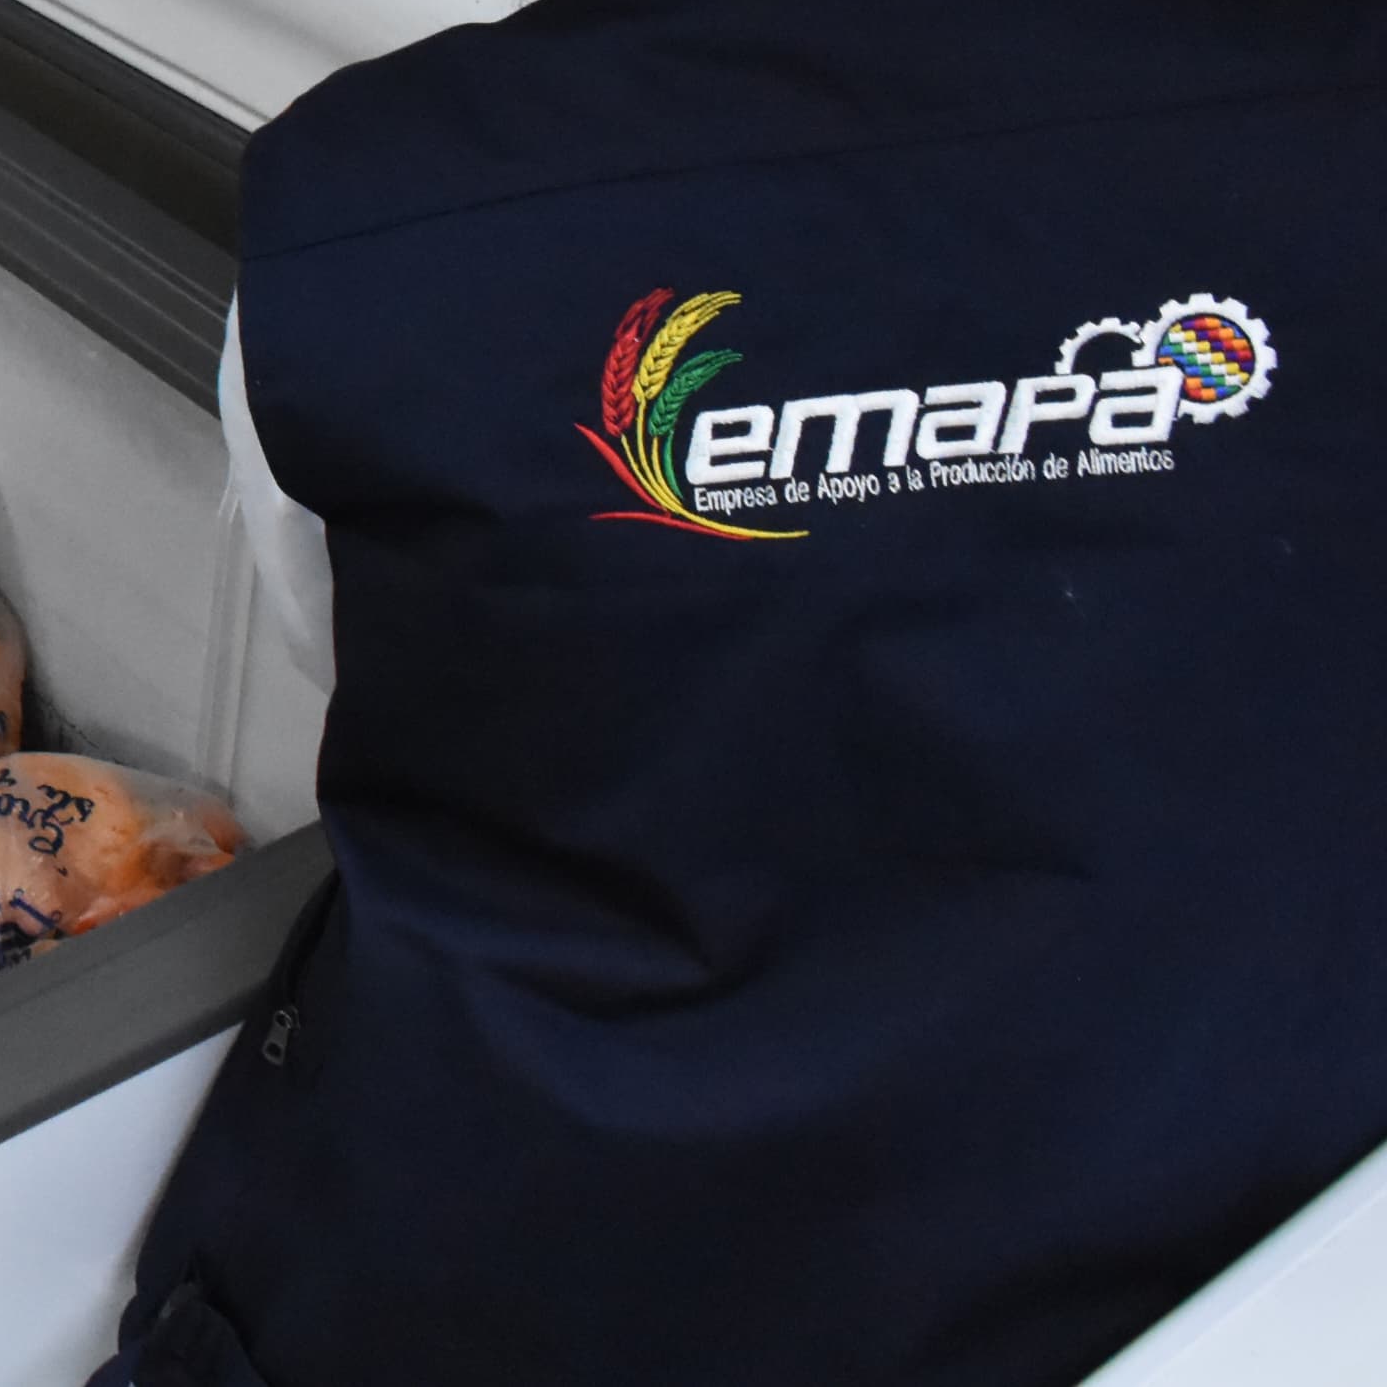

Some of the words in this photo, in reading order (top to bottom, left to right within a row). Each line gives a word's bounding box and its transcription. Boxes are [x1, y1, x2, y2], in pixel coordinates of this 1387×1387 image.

[685, 366, 1184, 486] emapa
[694, 484, 778, 516] Empresa
[784, 476, 811, 504] de
[816, 471, 881, 506] Apoyo
[887, 471, 901, 495] a
[906, 464, 925, 492] la
[929, 451, 1036, 489] Producción
[1043, 452, 1070, 481] de
[1077, 446, 1176, 478] Alimentos
